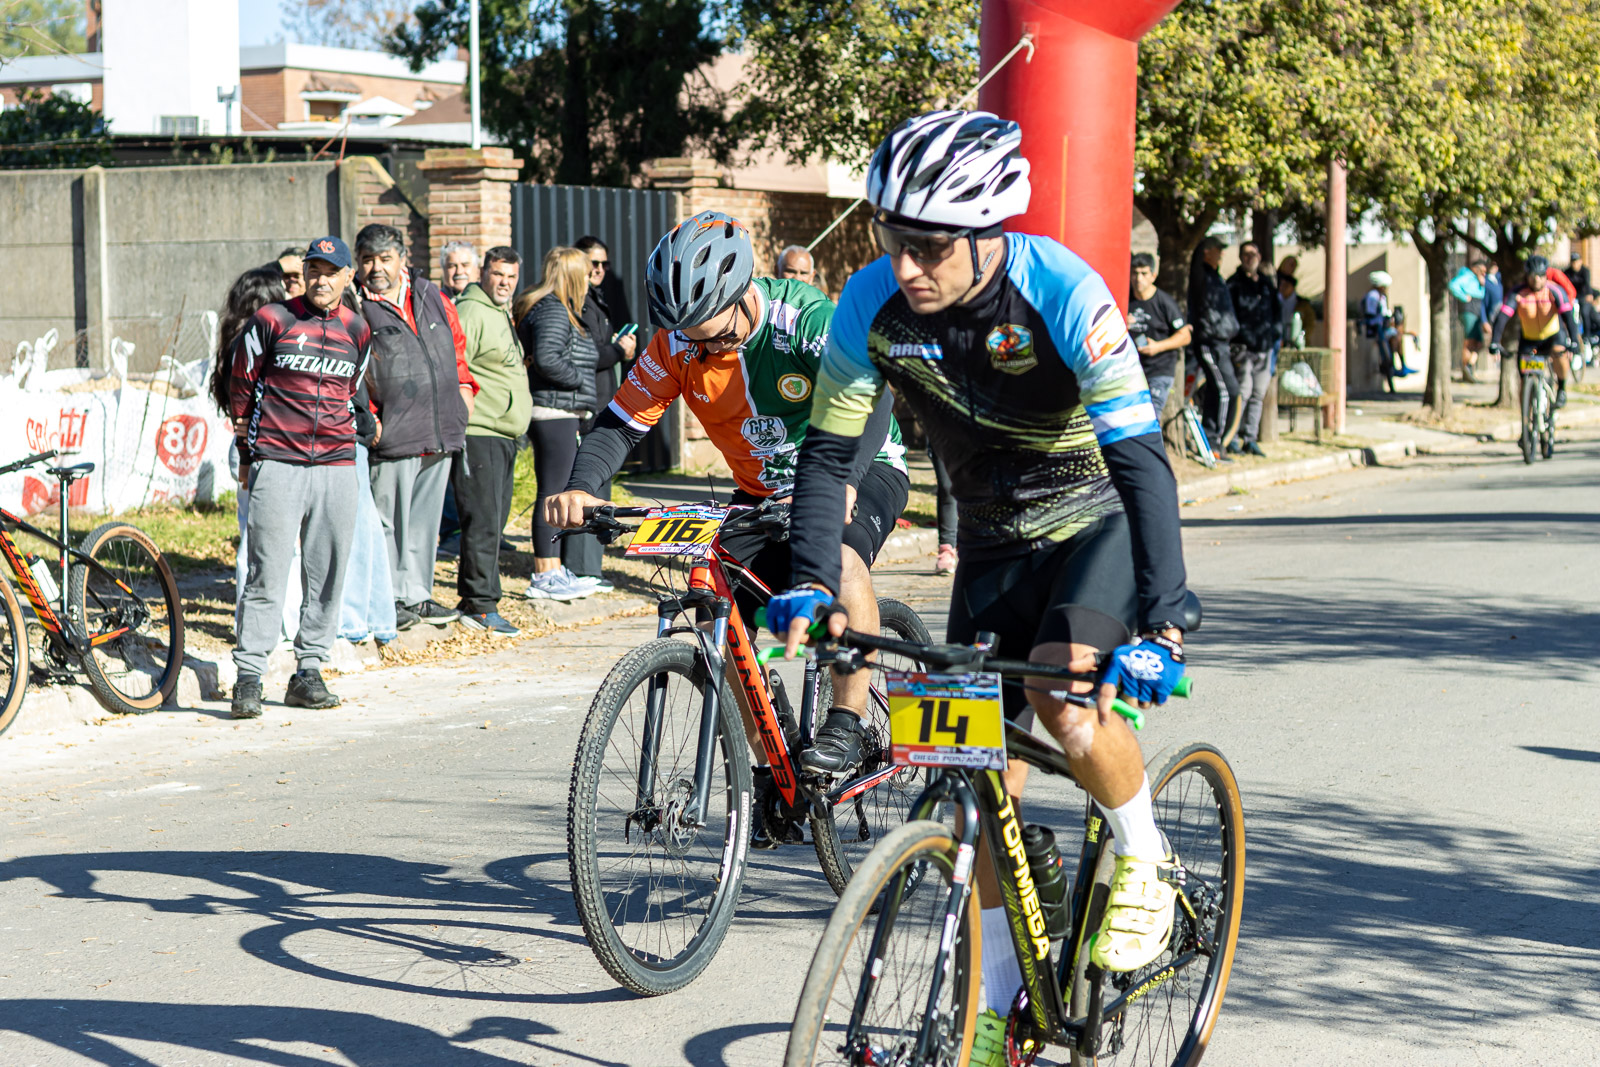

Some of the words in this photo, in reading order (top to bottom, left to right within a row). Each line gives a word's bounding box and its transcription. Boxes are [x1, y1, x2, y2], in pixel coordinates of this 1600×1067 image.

[273, 354, 356, 378] SPECIALIZE
[163, 420, 206, 455] 80
[749, 418, 777, 435] GCR
[646, 519, 709, 543] 116
[917, 699, 969, 744] 14
[998, 794, 1050, 961] TOPMEGA
